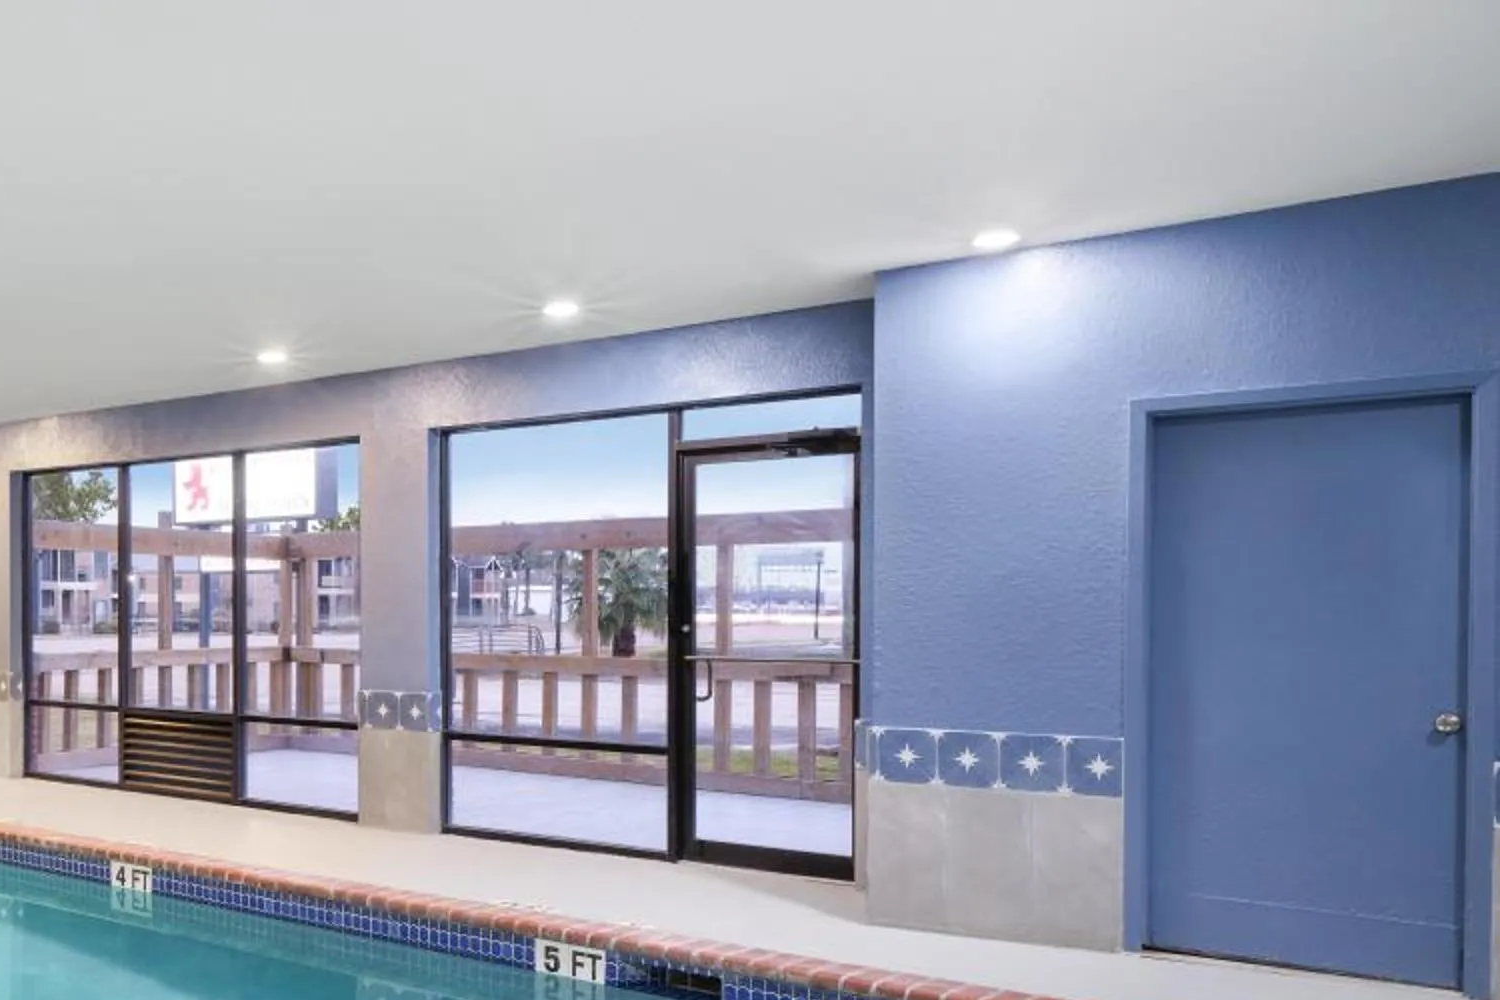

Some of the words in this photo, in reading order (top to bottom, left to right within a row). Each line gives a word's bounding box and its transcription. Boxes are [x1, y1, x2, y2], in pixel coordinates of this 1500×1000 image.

[115, 865, 126, 886] 4
[131, 869, 150, 891] FT
[543, 945, 561, 973] 5
[571, 950, 603, 981] FT
